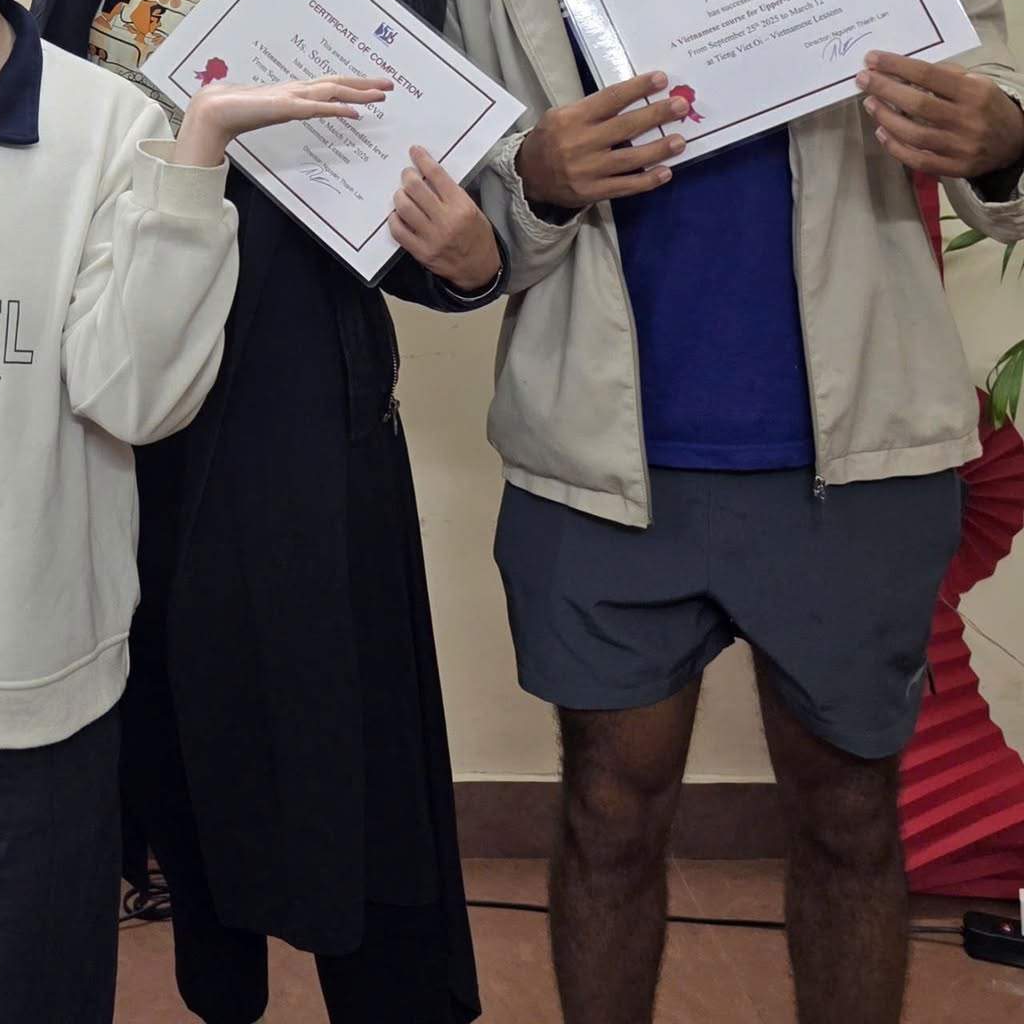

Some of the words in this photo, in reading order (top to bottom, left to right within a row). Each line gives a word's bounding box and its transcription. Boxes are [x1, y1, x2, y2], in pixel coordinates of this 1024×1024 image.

[677, 24, 720, 44] Vietnamese
[721, 15, 746, 28] course
[746, 9, 758, 18] for
[688, 45, 708, 57] From
[708, 30, 745, 49] September
[760, 14, 780, 28] 2025
[789, 2, 814, 16] March
[707, 9, 720, 18] has
[736, 43, 754, 52] Viet
[770, 18, 813, 39] Vietnamese
[812, 7, 843, 23] Lessons
[259, 44, 290, 74] Vietnamese
[291, 34, 307, 53] Ms.
[309, 0, 358, 44] CERTIFICATE
[358, 42, 371, 54] OF
[370, 53, 423, 99] COMPLETION
[332, 50, 351, 66] award
[349, 64, 367, 79] certif
[336, 114, 374, 150] ntermediate
[373, 145, 388, 160] level
